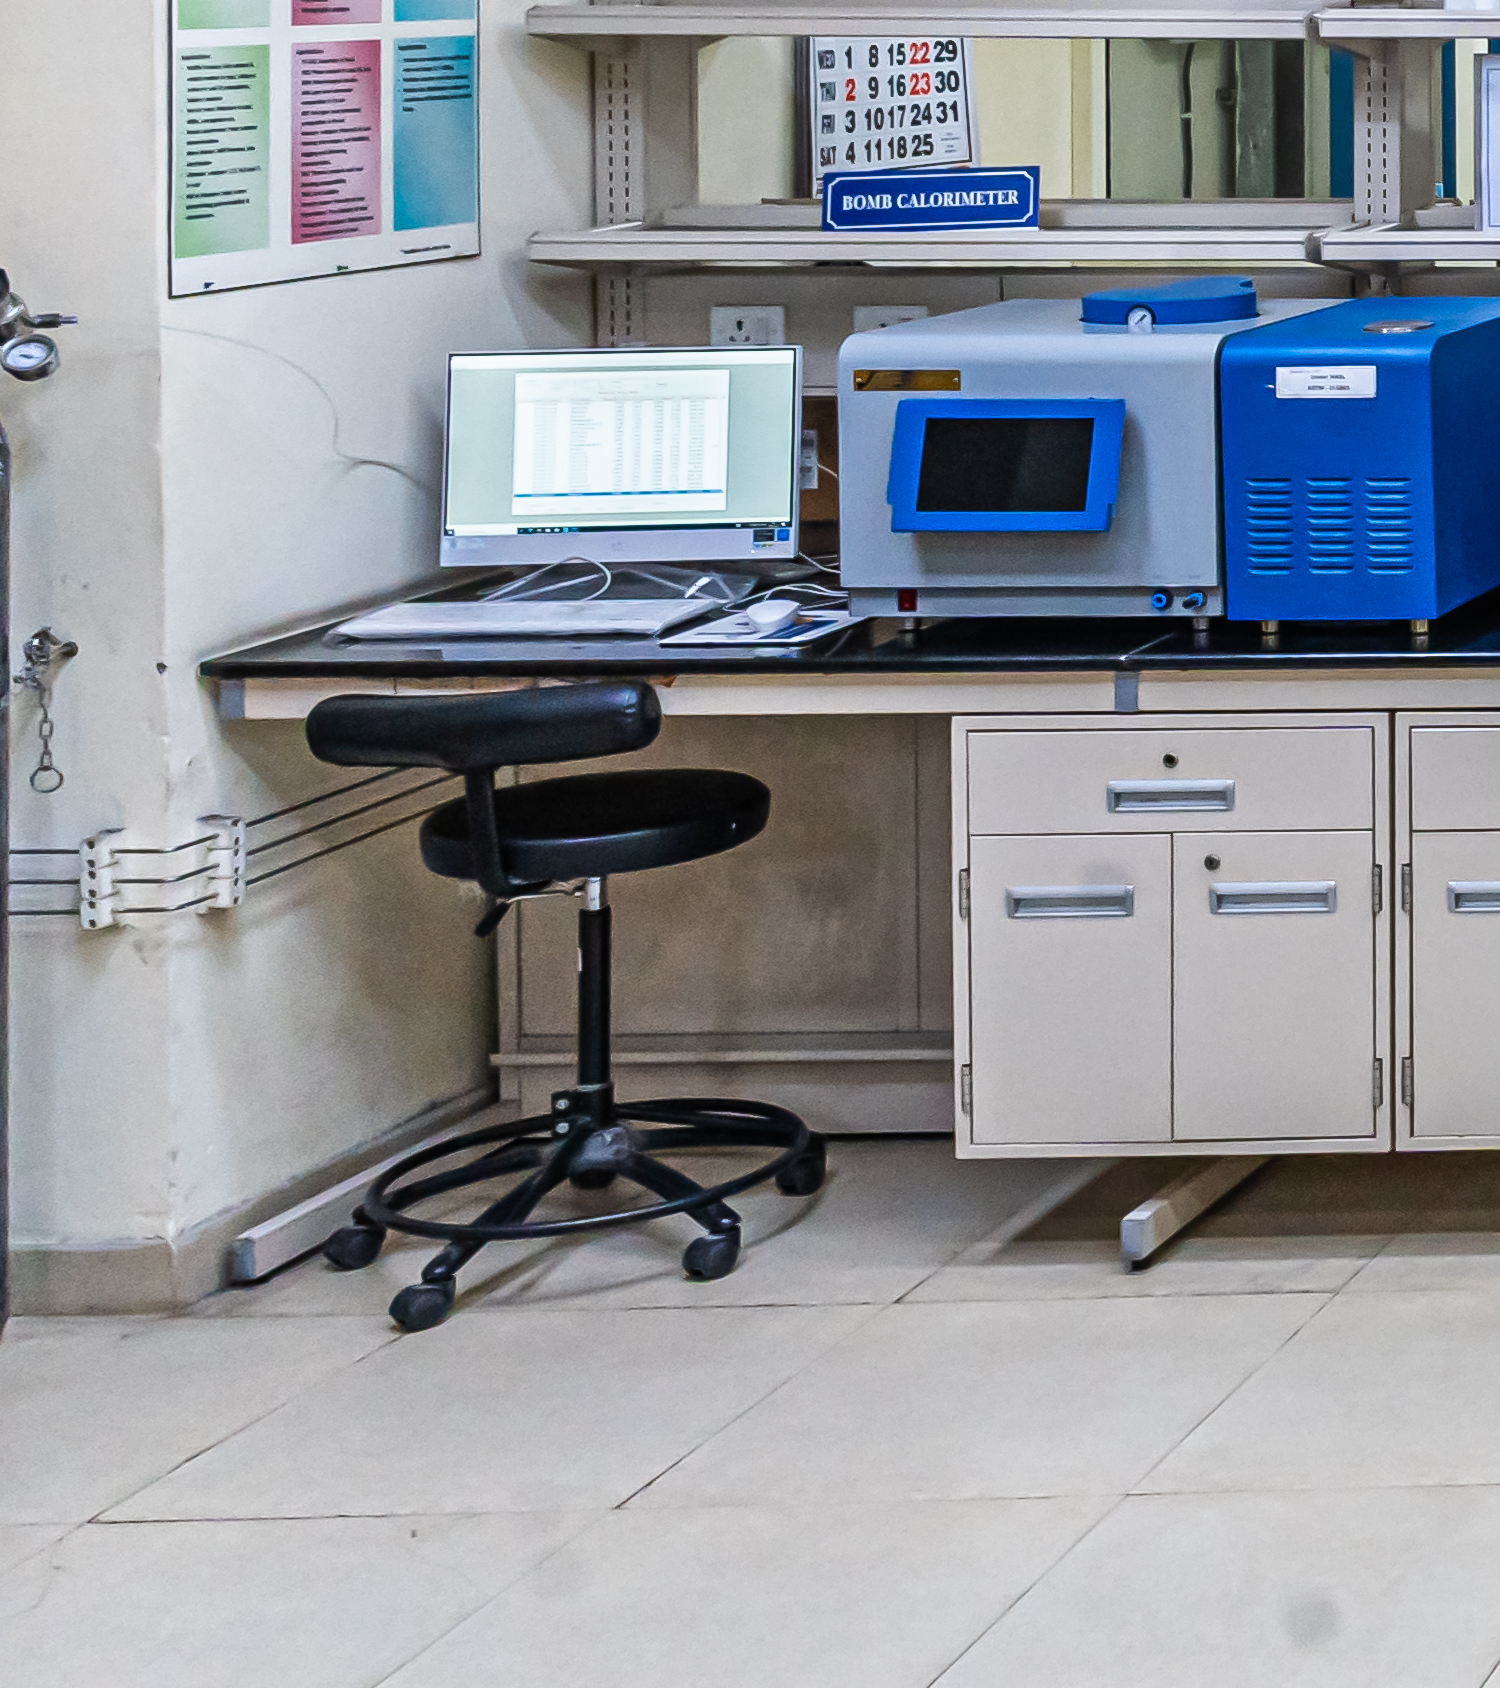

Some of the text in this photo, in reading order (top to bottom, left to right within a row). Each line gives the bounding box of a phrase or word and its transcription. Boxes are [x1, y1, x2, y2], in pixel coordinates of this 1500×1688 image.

[844, 45, 852, 69] 1
[868, 44, 879, 68] 8
[887, 43, 906, 66] 15
[909, 41, 930, 64] 22
[933, 40, 958, 62] 29
[845, 78, 856, 101] 2
[868, 77, 879, 99] 9
[887, 74, 906, 97] 16
[909, 72, 931, 95] 23
[934, 70, 960, 93] 30
[844, 110, 856, 133] 3
[864, 107, 884, 130] 10
[888, 105, 906, 128] 17
[910, 102, 932, 126] 24
[935, 100, 959, 123] 31
[845, 142, 856, 164] 4
[864, 139, 882, 162] 11
[888, 136, 907, 159] 18
[911, 134, 934, 157] 25
[842, 189, 1019, 211] BOMB CALORIMETER
